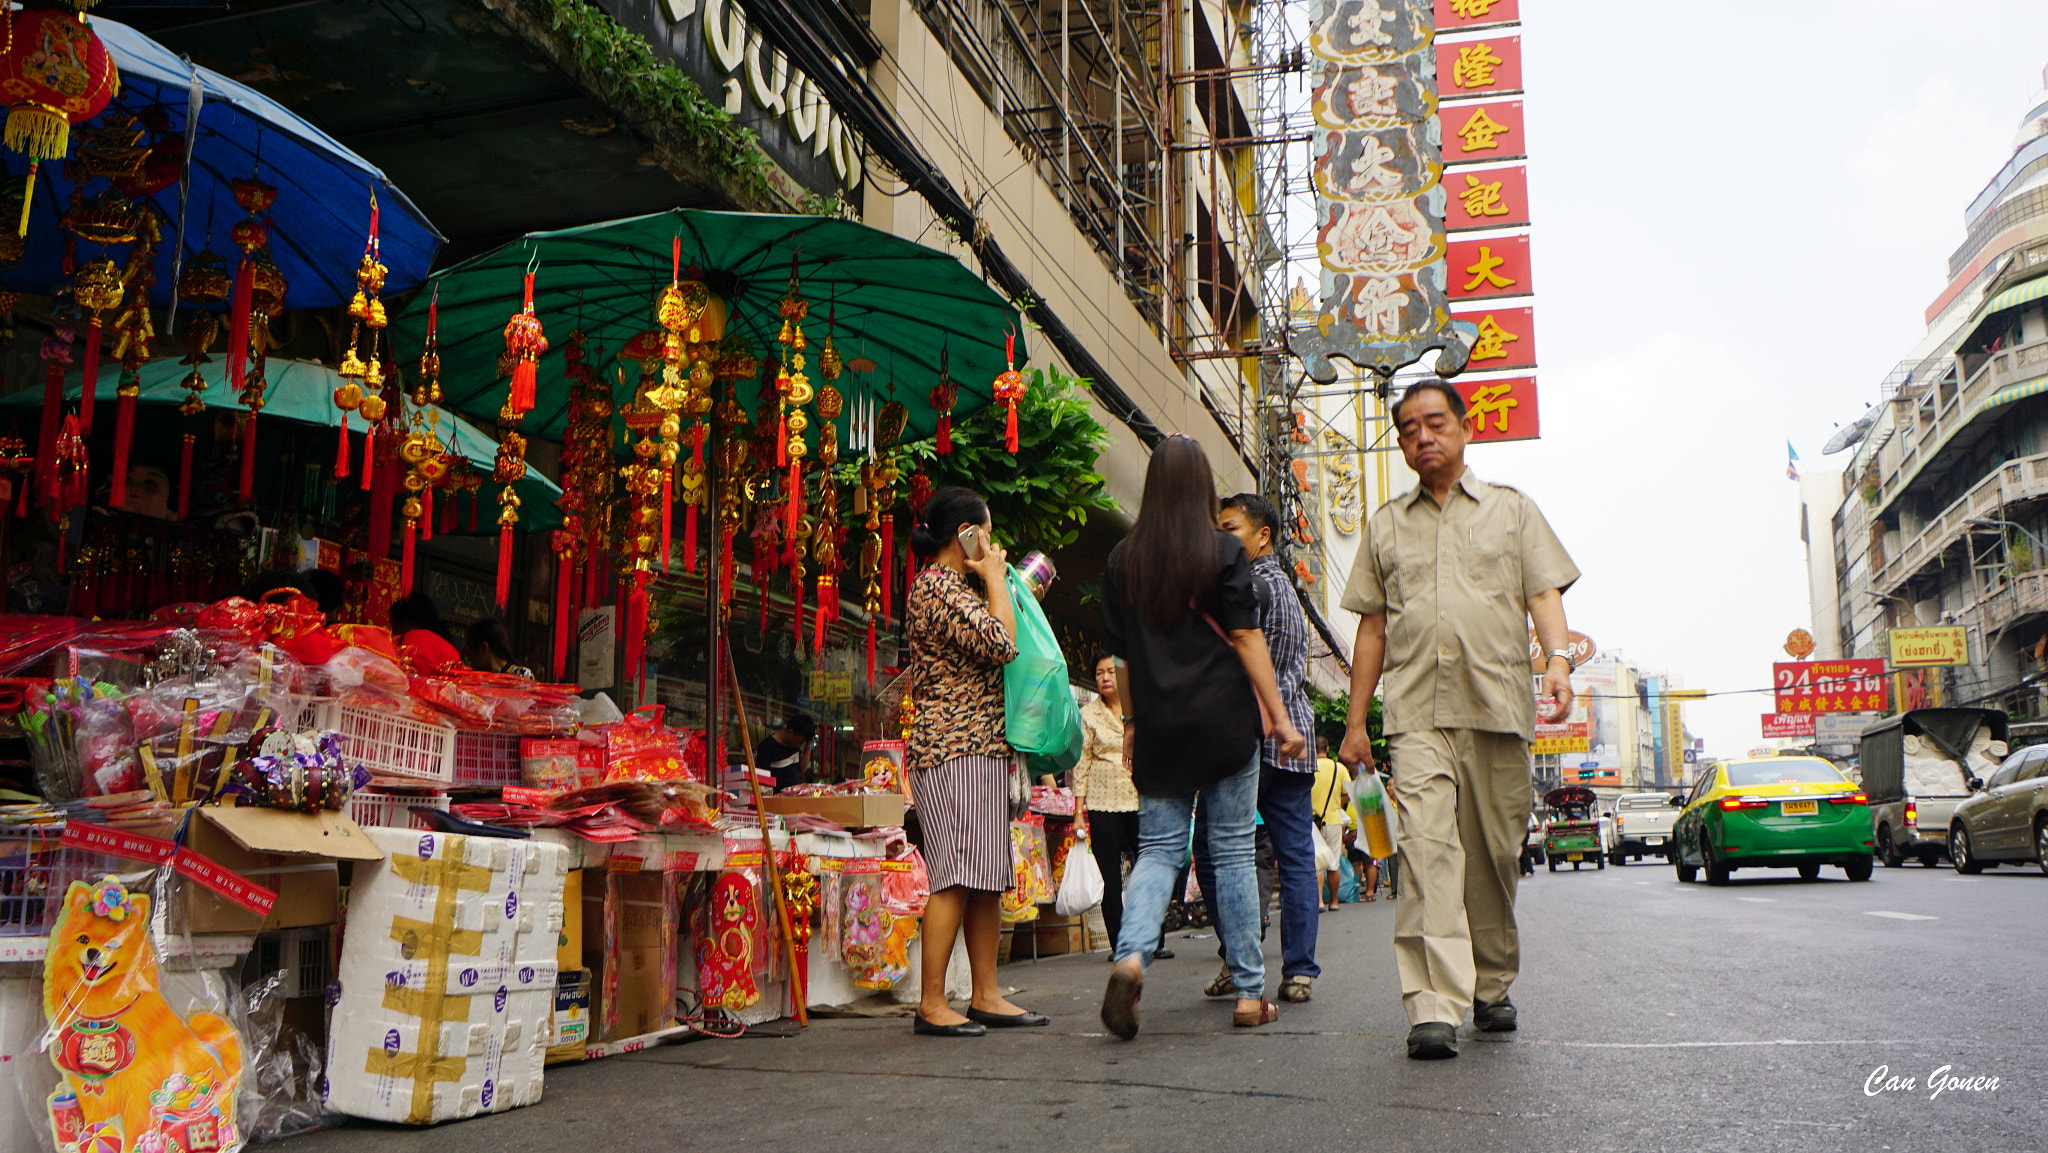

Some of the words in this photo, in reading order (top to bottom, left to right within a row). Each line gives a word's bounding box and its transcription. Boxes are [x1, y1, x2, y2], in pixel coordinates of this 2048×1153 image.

[1811, 663, 1850, 675] ห้างทอง
[1779, 669, 1813, 696] 24
[1817, 667, 1881, 694] กะรัต
[460, 968, 478, 986] WL
[519, 967, 534, 983] WL
[187, 1119, 218, 1151] 旺
